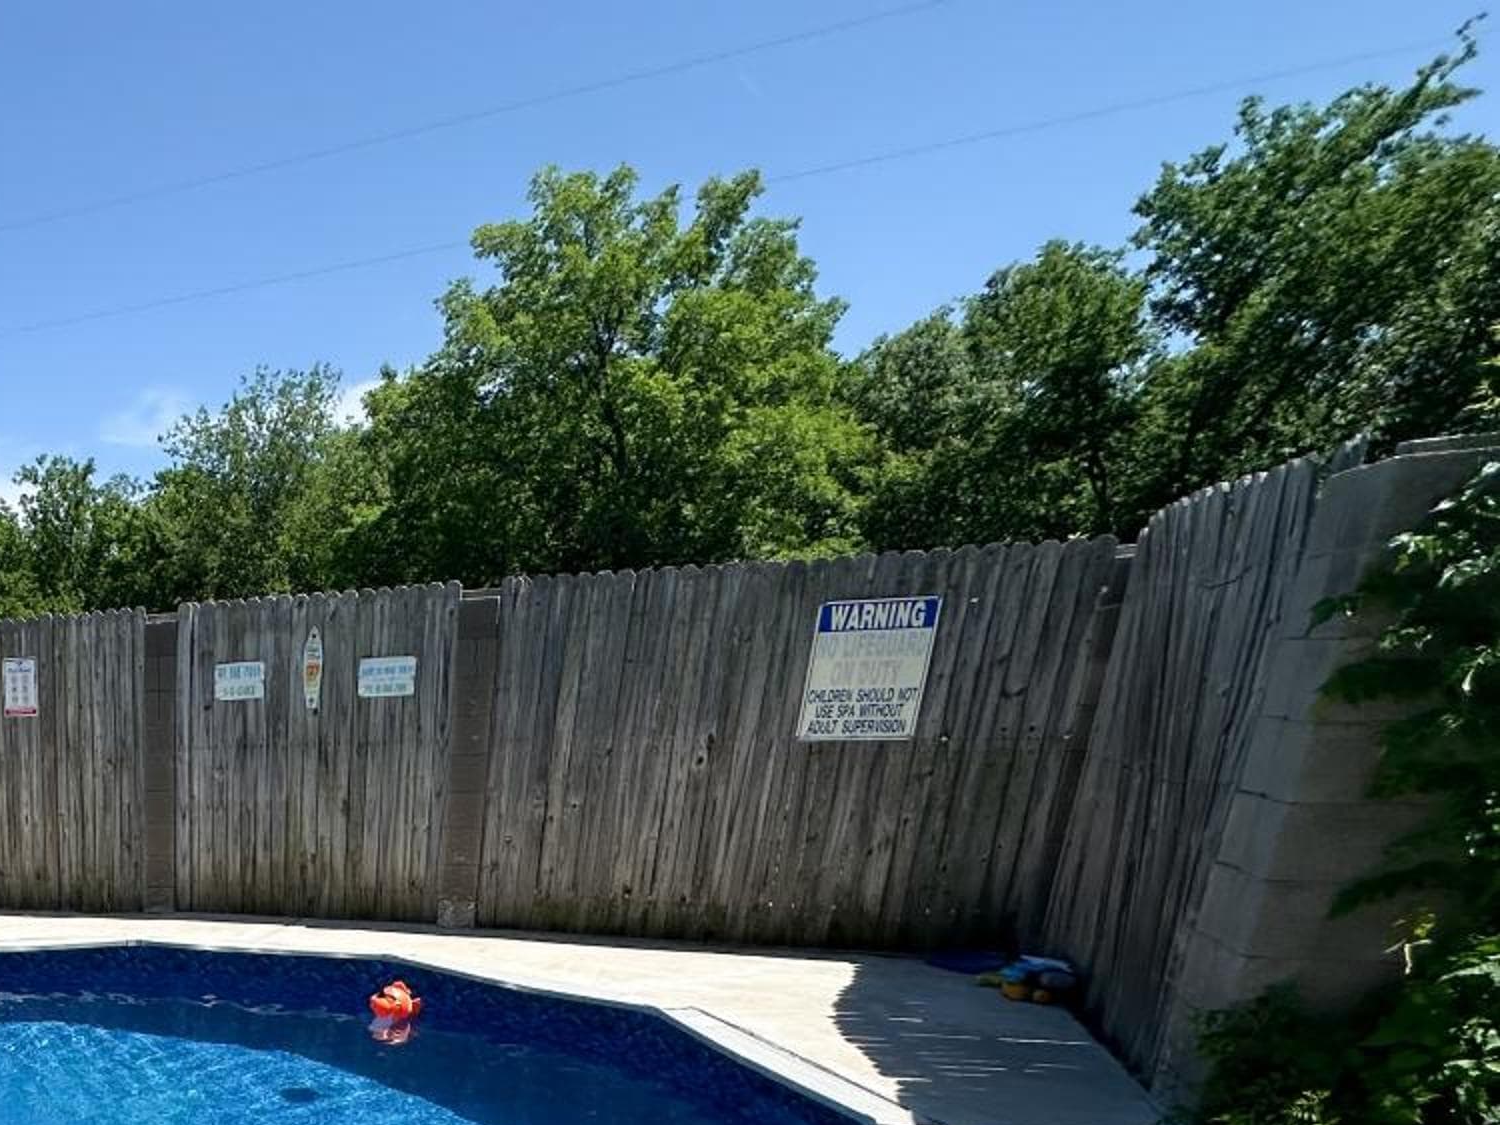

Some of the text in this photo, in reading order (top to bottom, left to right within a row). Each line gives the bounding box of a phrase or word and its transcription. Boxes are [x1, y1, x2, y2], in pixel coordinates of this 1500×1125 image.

[831, 601, 927, 631] WARNING
[856, 688, 895, 703] SHOULD
[898, 687, 919, 702] NOT
[815, 703, 904, 719] USE SPA WITHOUT
[808, 719, 907, 735] ADULT SUPERVISION
